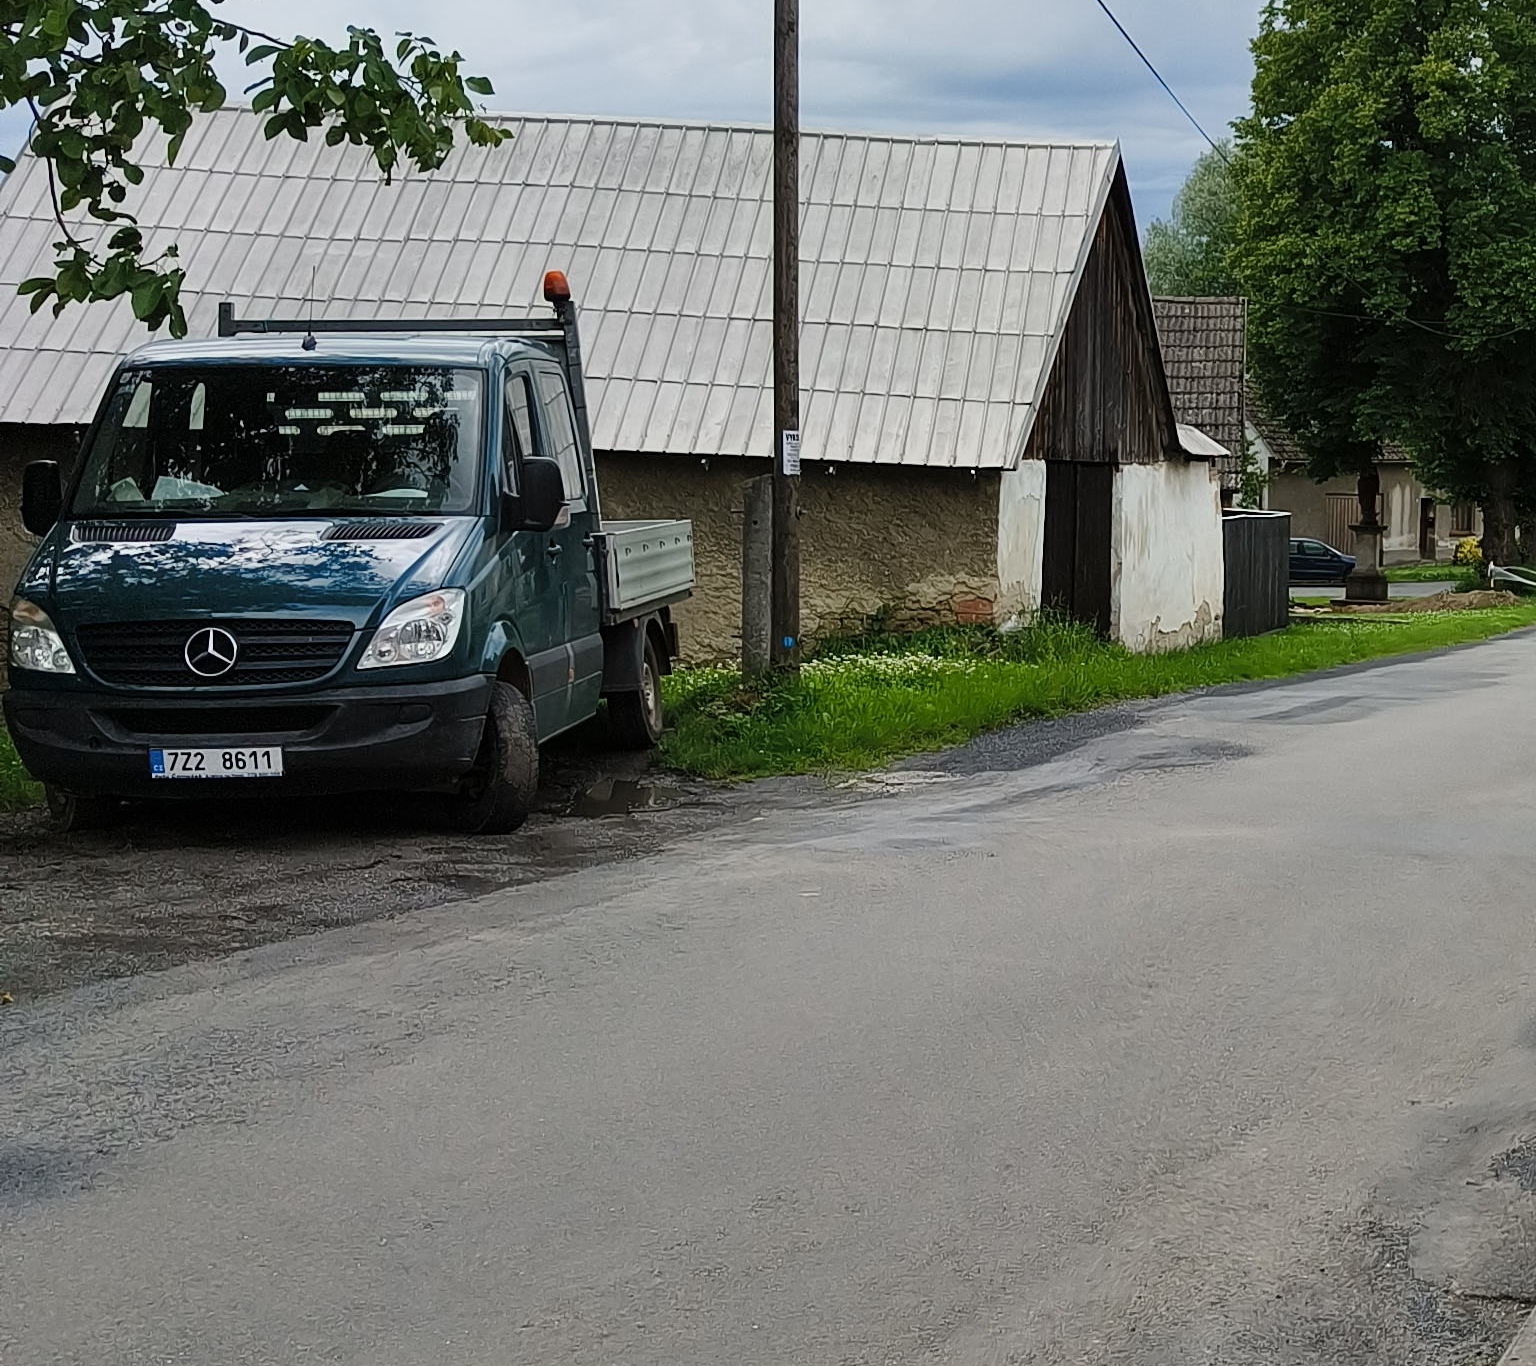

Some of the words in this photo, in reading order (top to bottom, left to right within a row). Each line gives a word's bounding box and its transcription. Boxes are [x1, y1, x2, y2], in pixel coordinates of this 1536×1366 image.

[153, 764, 164, 772] CZ
[167, 752, 206, 772] 7Z2
[221, 750, 272, 770] 8611
